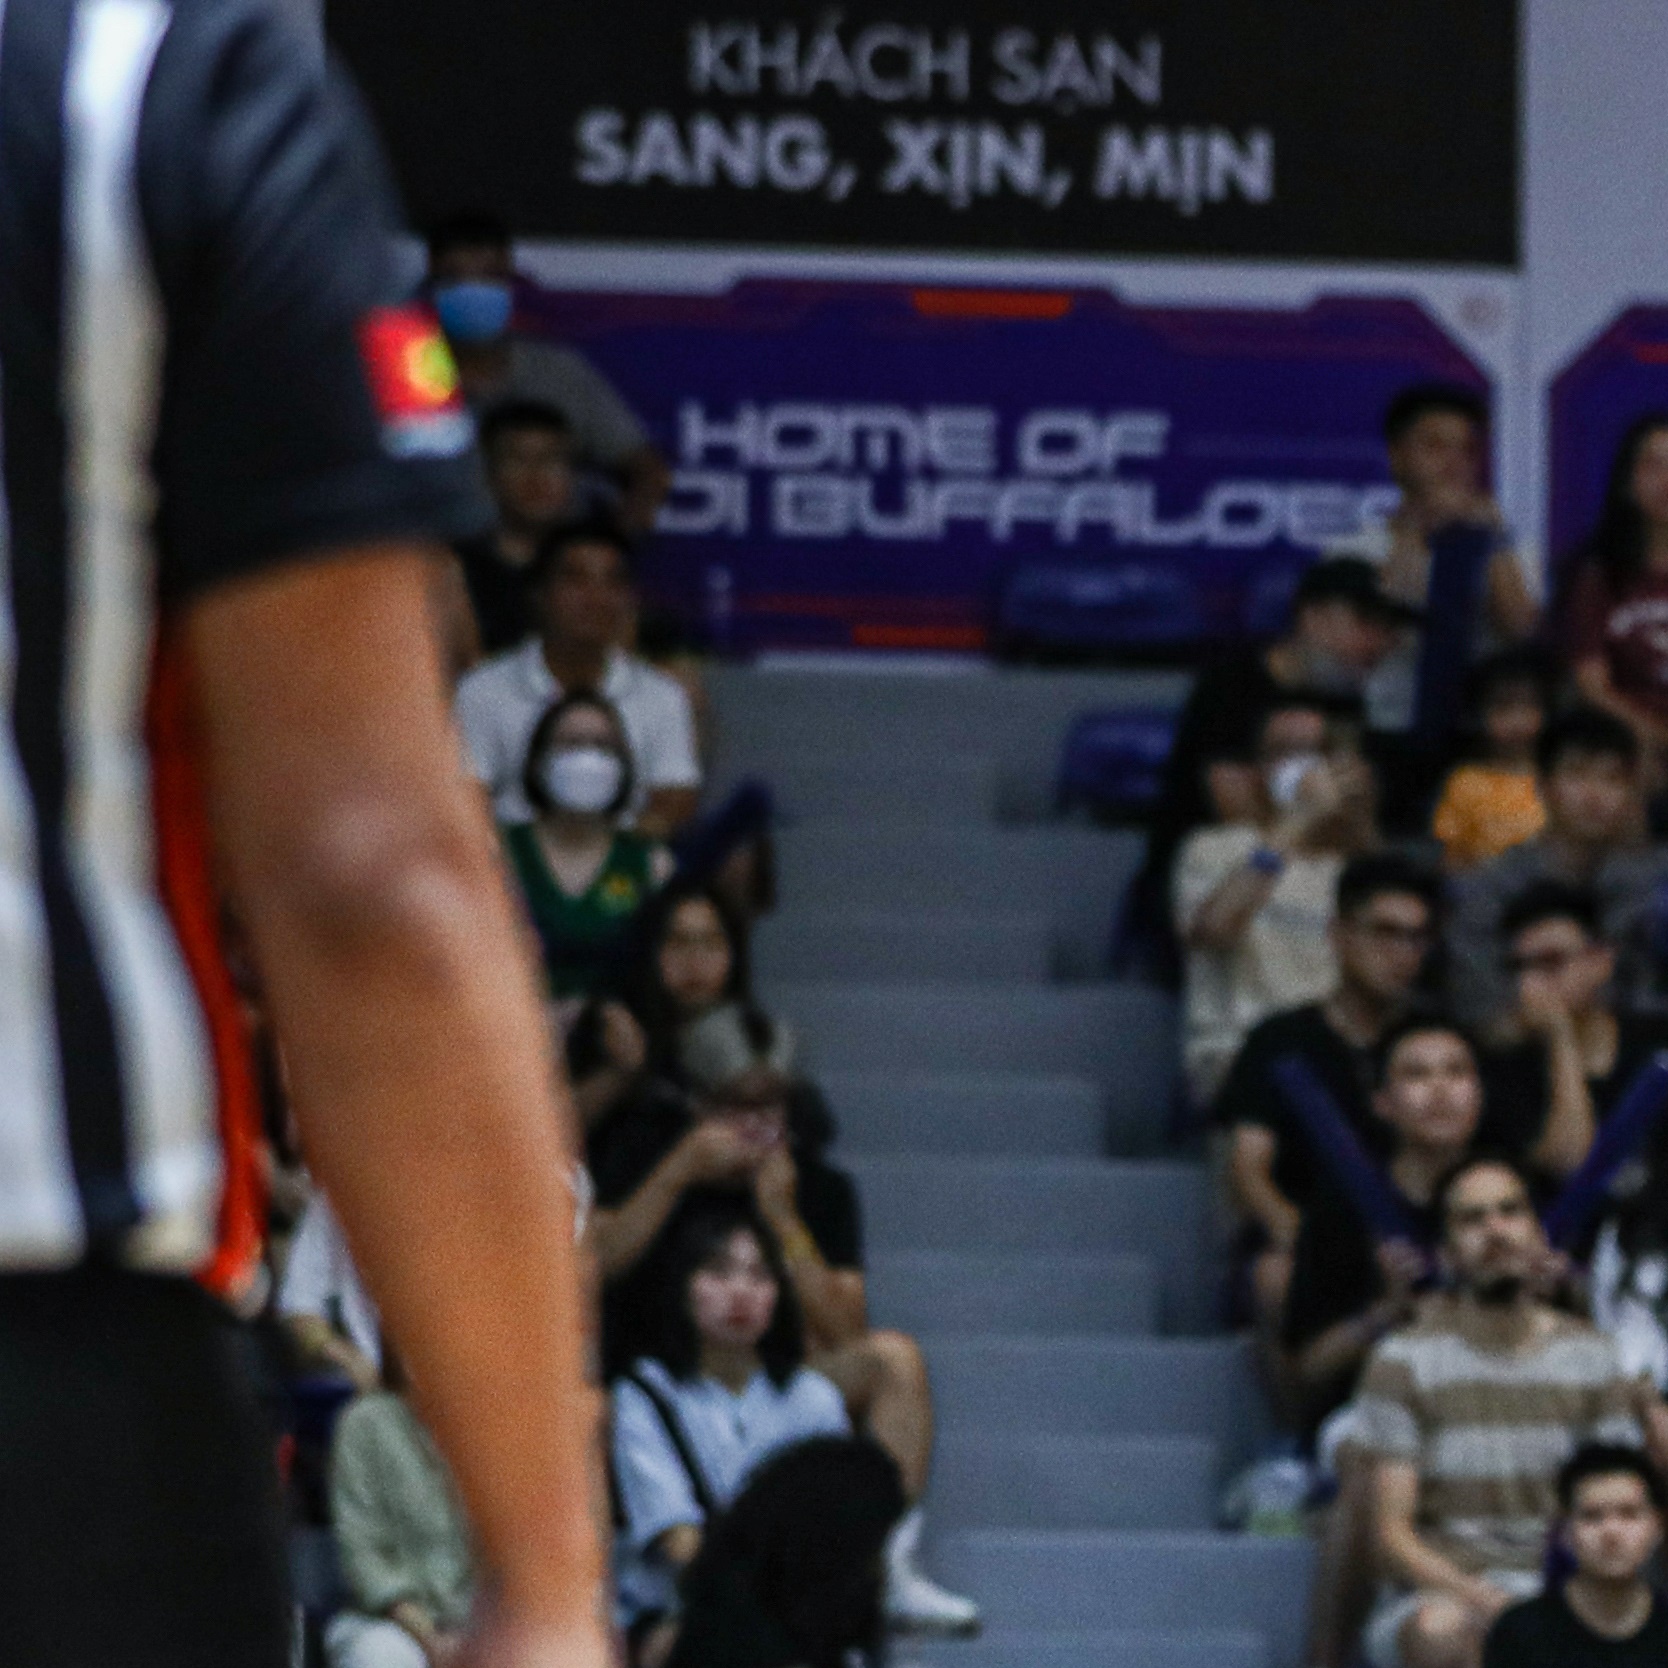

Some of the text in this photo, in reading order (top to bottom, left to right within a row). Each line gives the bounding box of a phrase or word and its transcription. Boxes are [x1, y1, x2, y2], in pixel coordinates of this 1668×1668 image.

[687, 12, 1164, 114] KHÁCH SẠN
[576, 108, 857, 202] SANG,
[1095, 124, 1276, 216] MỊN
[678, 402, 1171, 477] HOME OF
